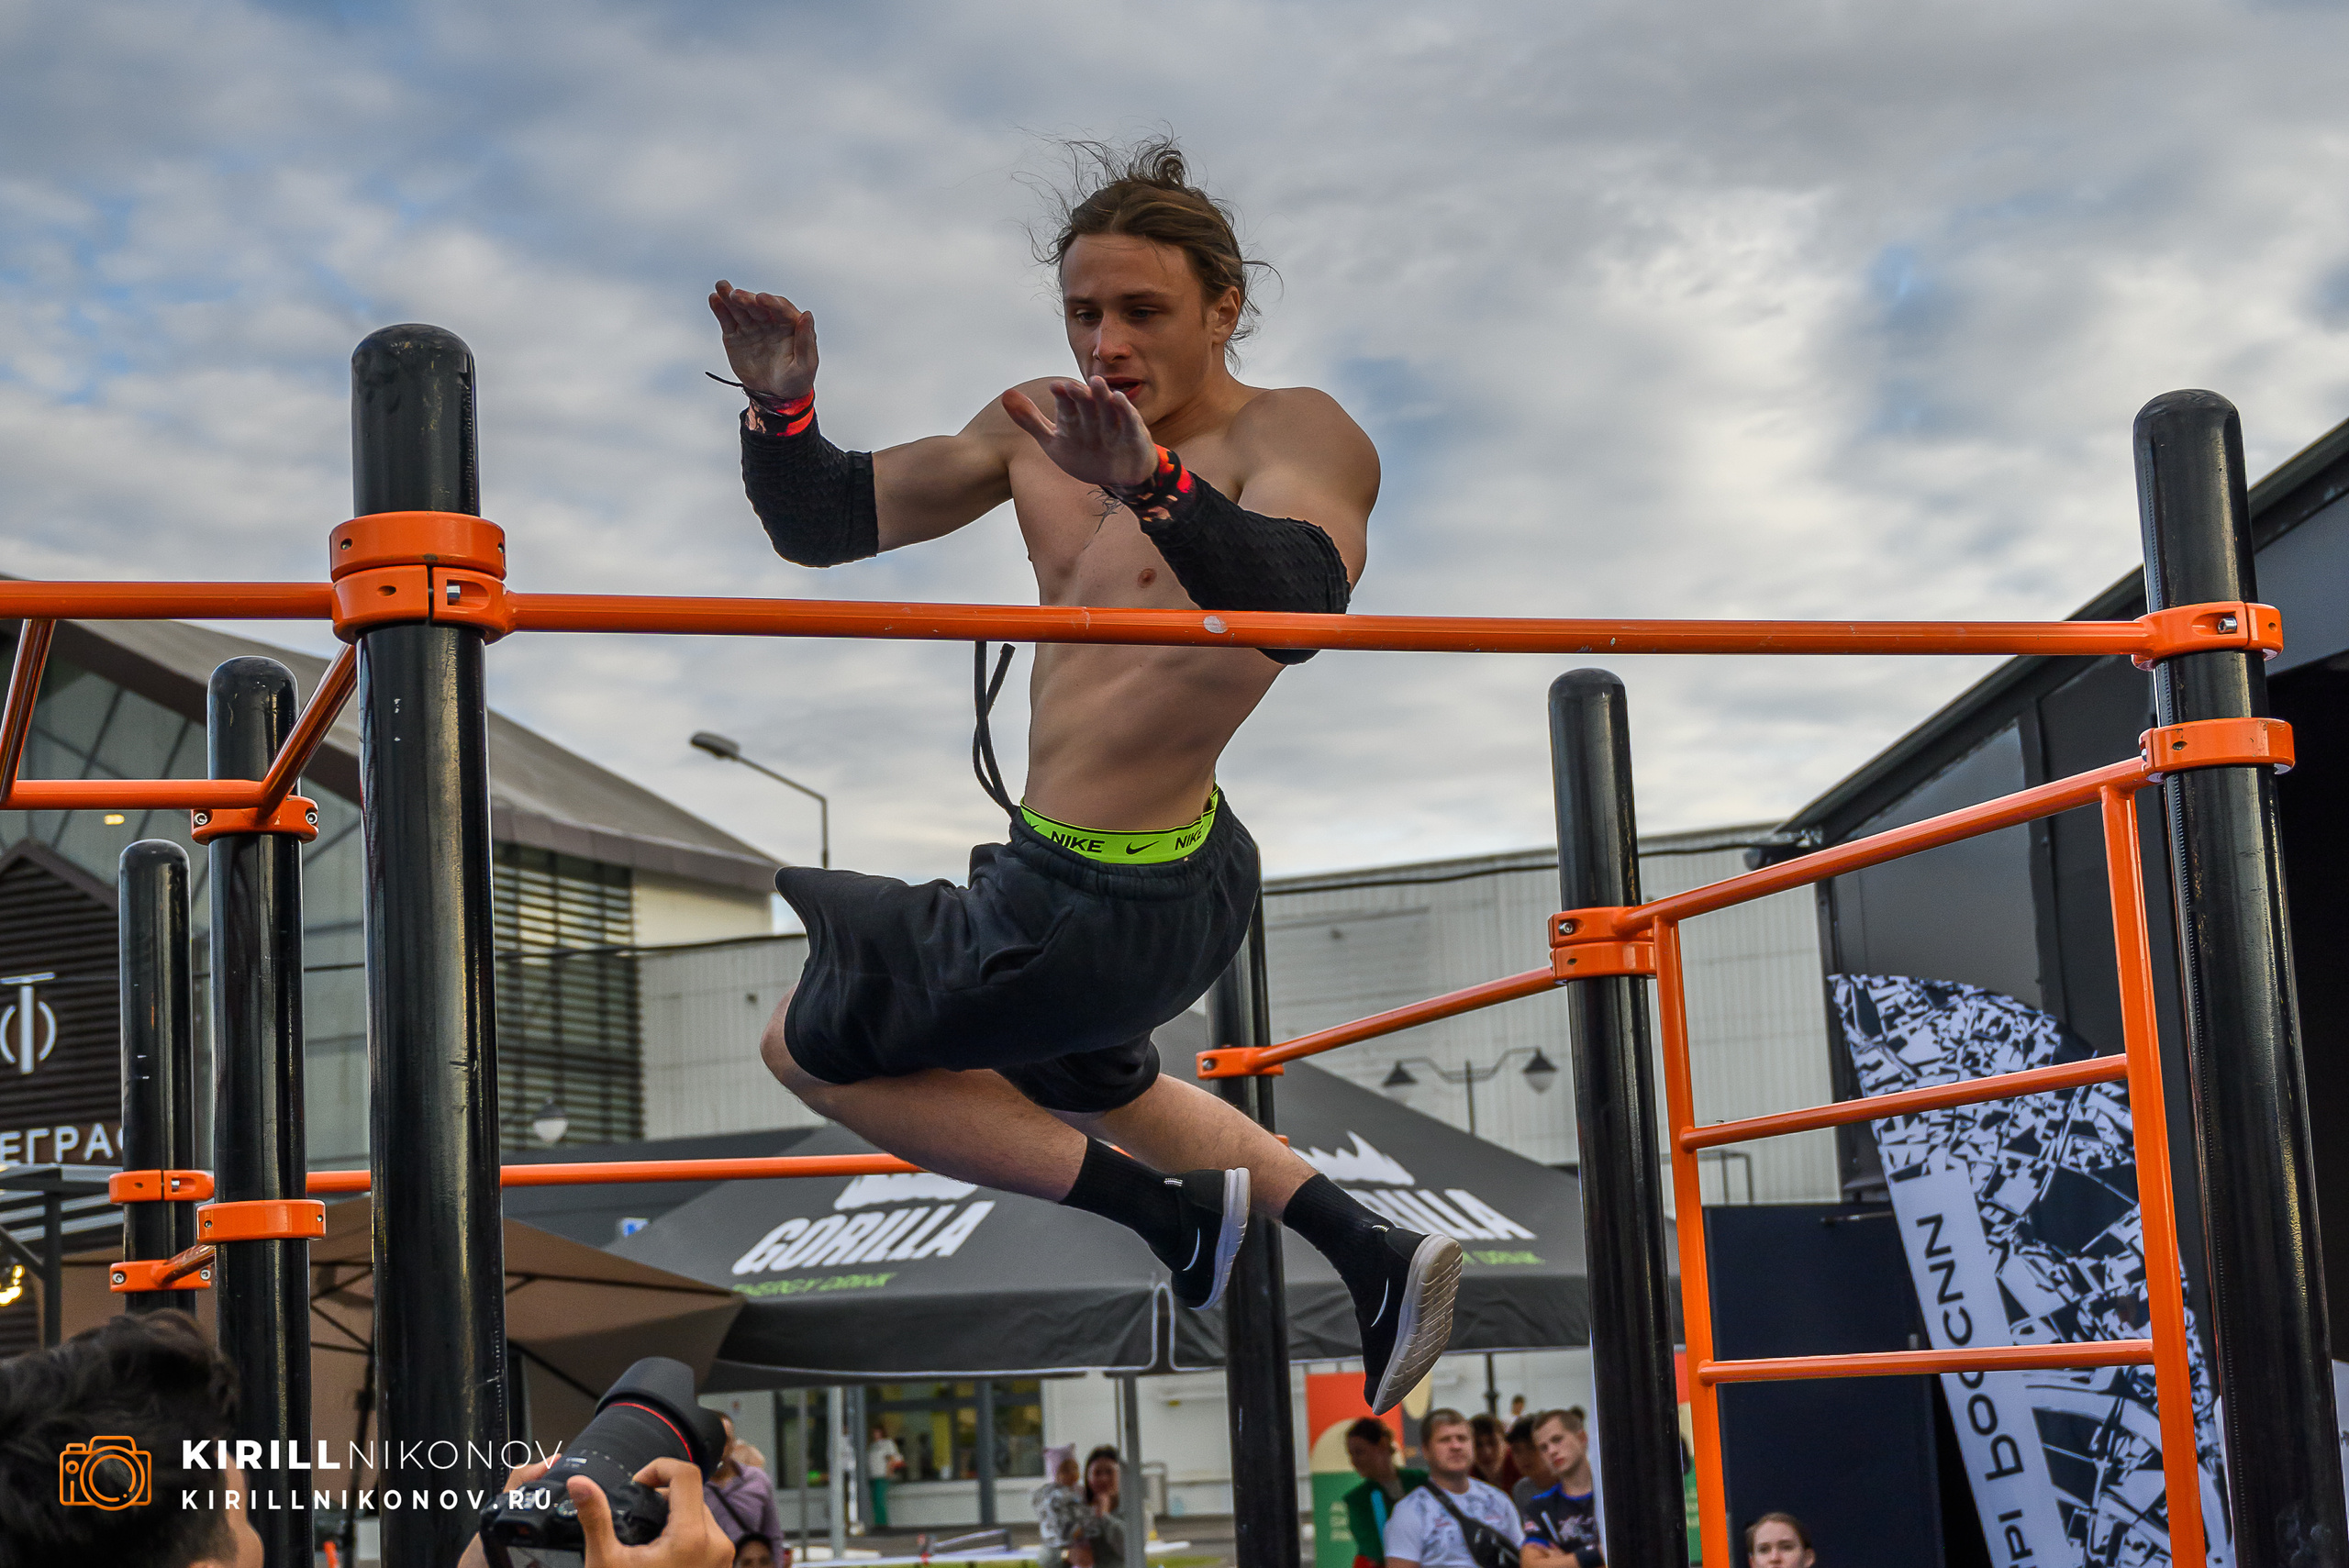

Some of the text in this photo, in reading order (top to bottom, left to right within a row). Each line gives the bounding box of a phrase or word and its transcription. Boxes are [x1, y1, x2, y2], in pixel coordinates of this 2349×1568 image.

[1051, 830, 1105, 853] NIKE
[1174, 825, 1204, 851] NIKE
[0, 1122, 123, 1165] ЕГРА
[1343, 1188, 1538, 1240] RILLA
[731, 1200, 996, 1275] GORILLA
